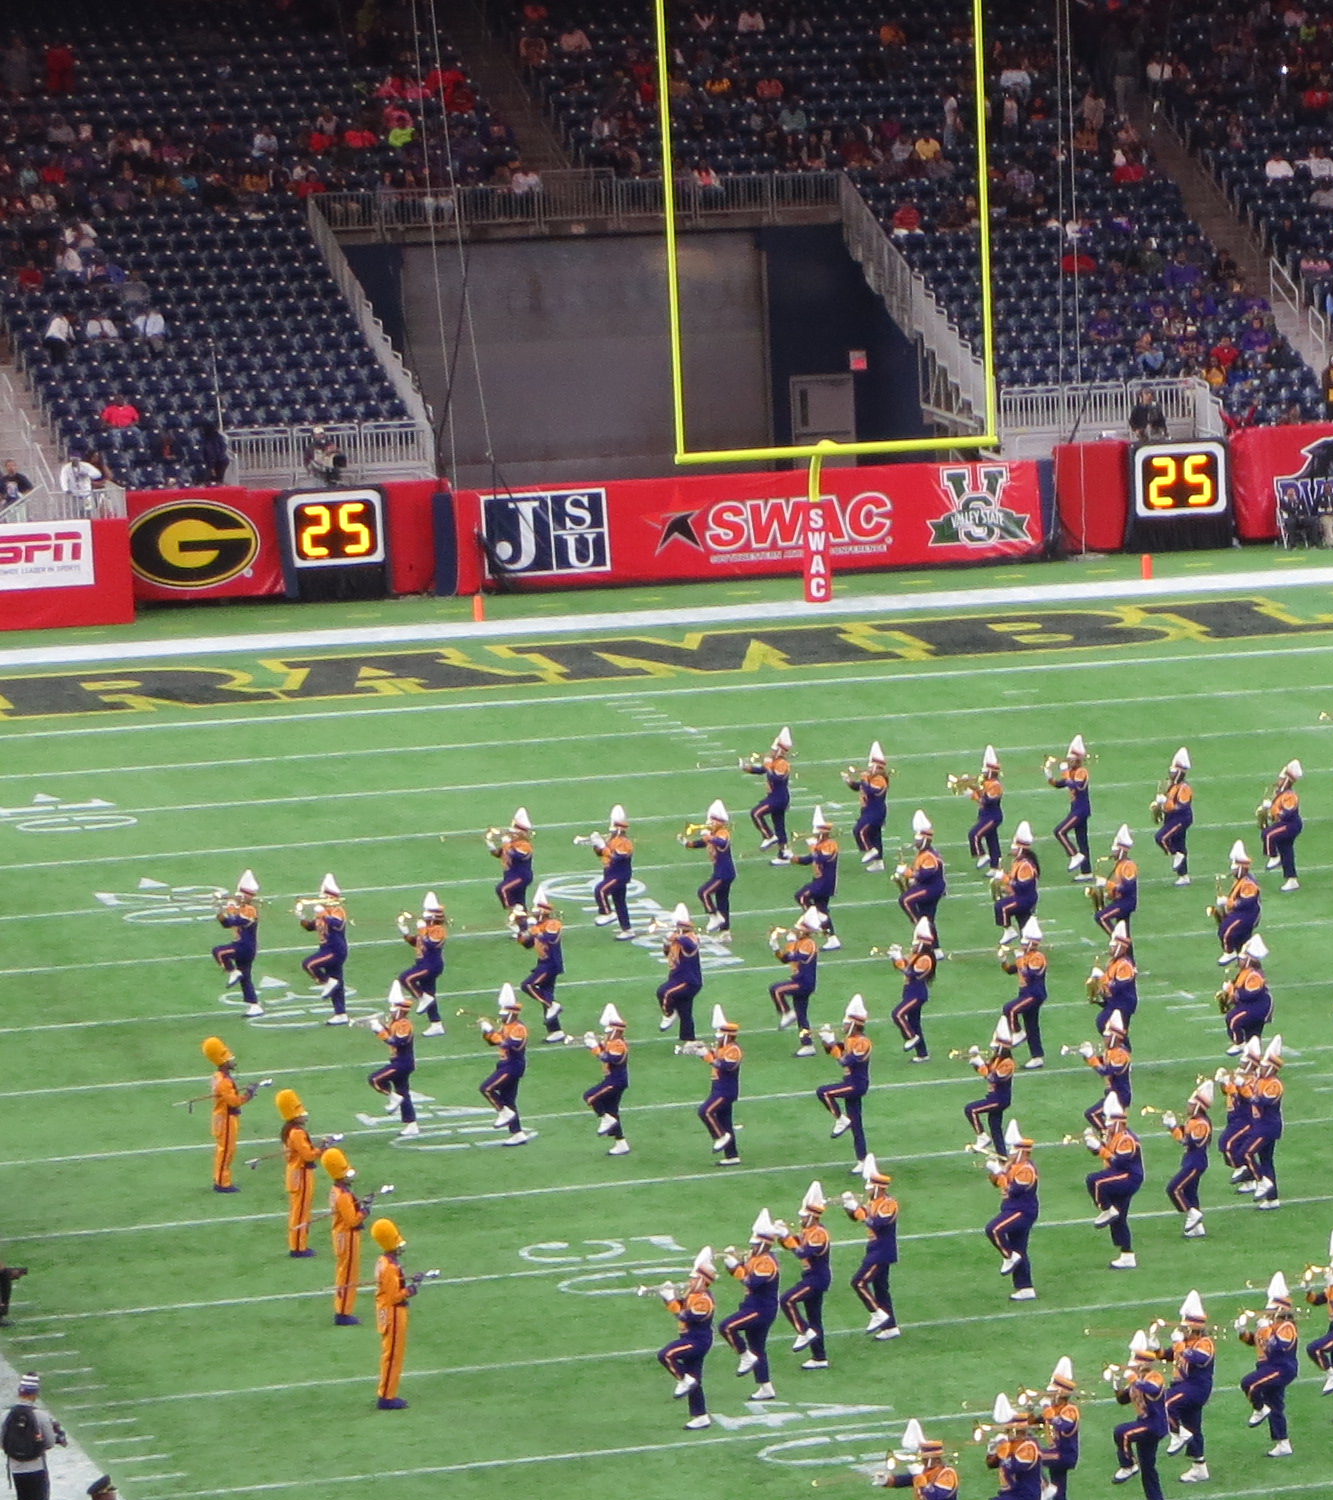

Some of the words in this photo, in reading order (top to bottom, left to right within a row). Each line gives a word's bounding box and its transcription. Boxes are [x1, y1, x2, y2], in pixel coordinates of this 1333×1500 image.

[1148, 454, 1212, 508] 25
[0, 531, 82, 565] SPN
[301, 501, 373, 557] 25
